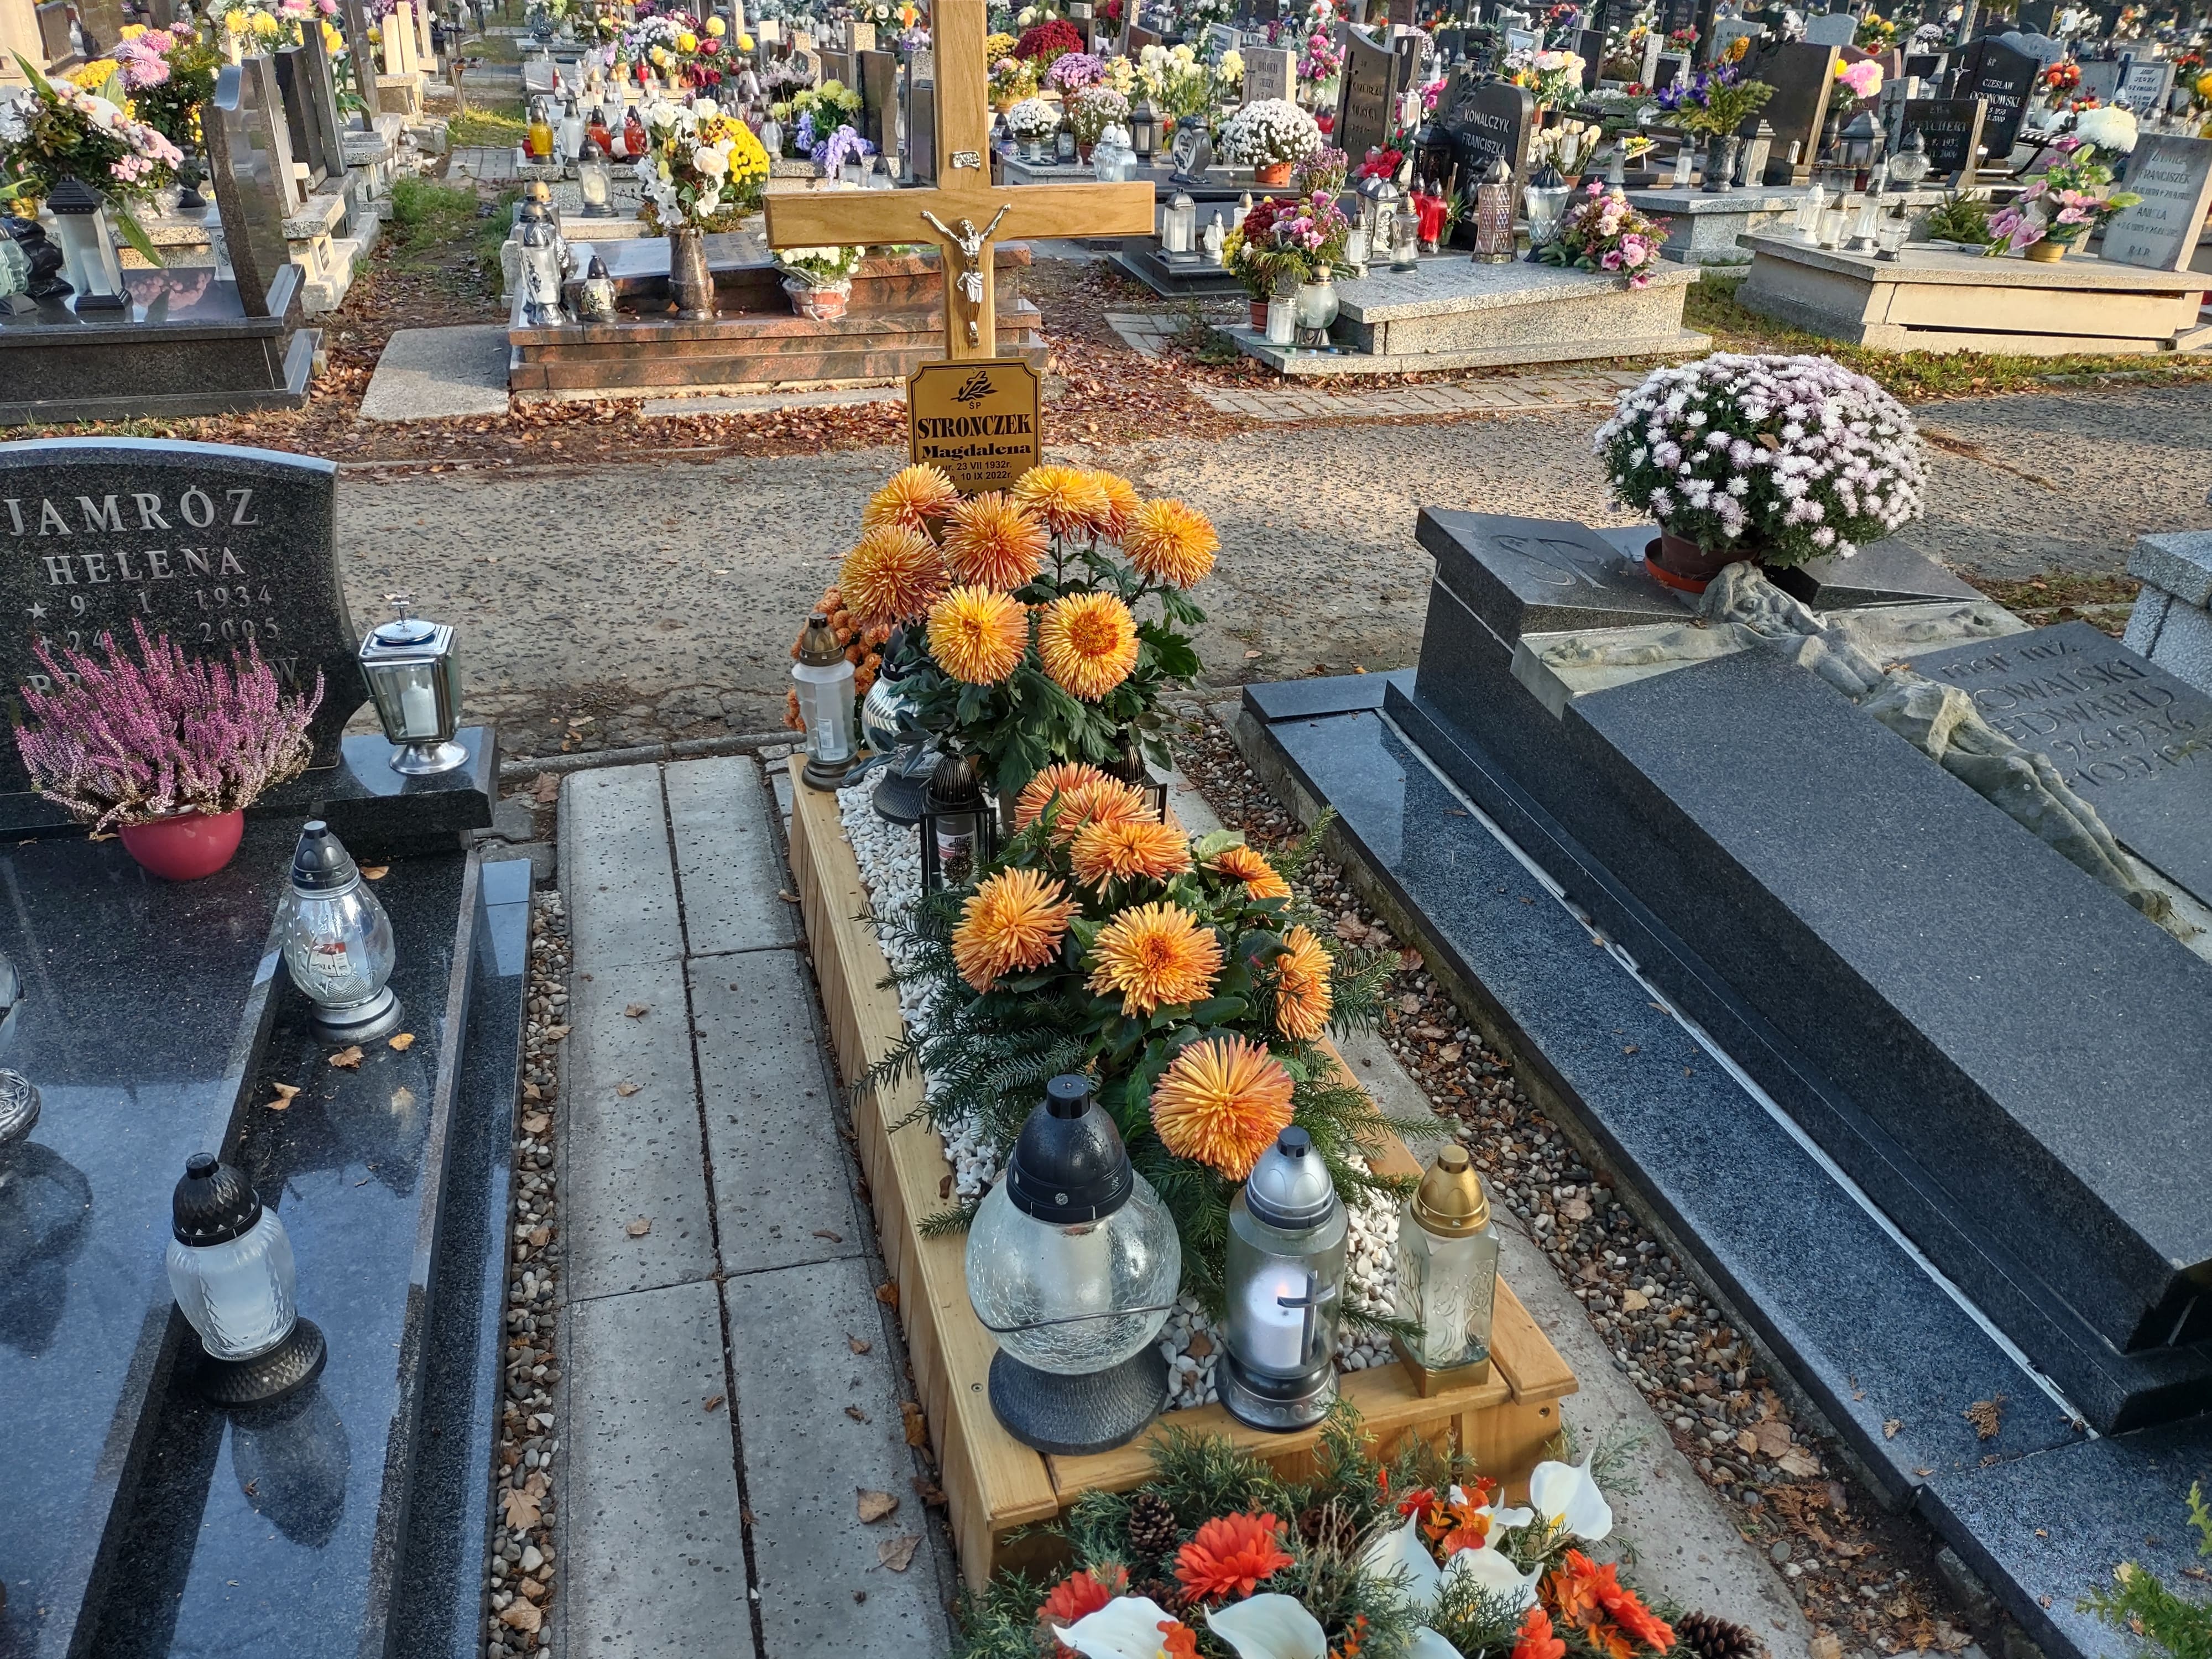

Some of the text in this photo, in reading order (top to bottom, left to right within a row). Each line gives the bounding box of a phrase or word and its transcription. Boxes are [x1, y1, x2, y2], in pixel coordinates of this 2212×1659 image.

[1465, 109, 1510, 133] KOWALCZYK
[1462, 132, 1506, 156] FRANCISZKA
[917, 414, 1032, 440] STRONCZEK
[921, 443, 1031, 461] Magdalena
[970, 461, 982, 469] VII
[985, 461, 1012, 469] 1932r.
[986, 471, 1013, 479] 2022r.
[3, 485, 260, 537] JAMRÓZ
[42, 546, 246, 586] HELENA
[70, 585, 272, 617] 9 1 1934
[67, 617, 278, 652] 24 2005
[1939, 653, 2010, 679] mgr
[1974, 659, 2150, 709] OWALSKI
[1989, 686, 2174, 740] EDWARD
